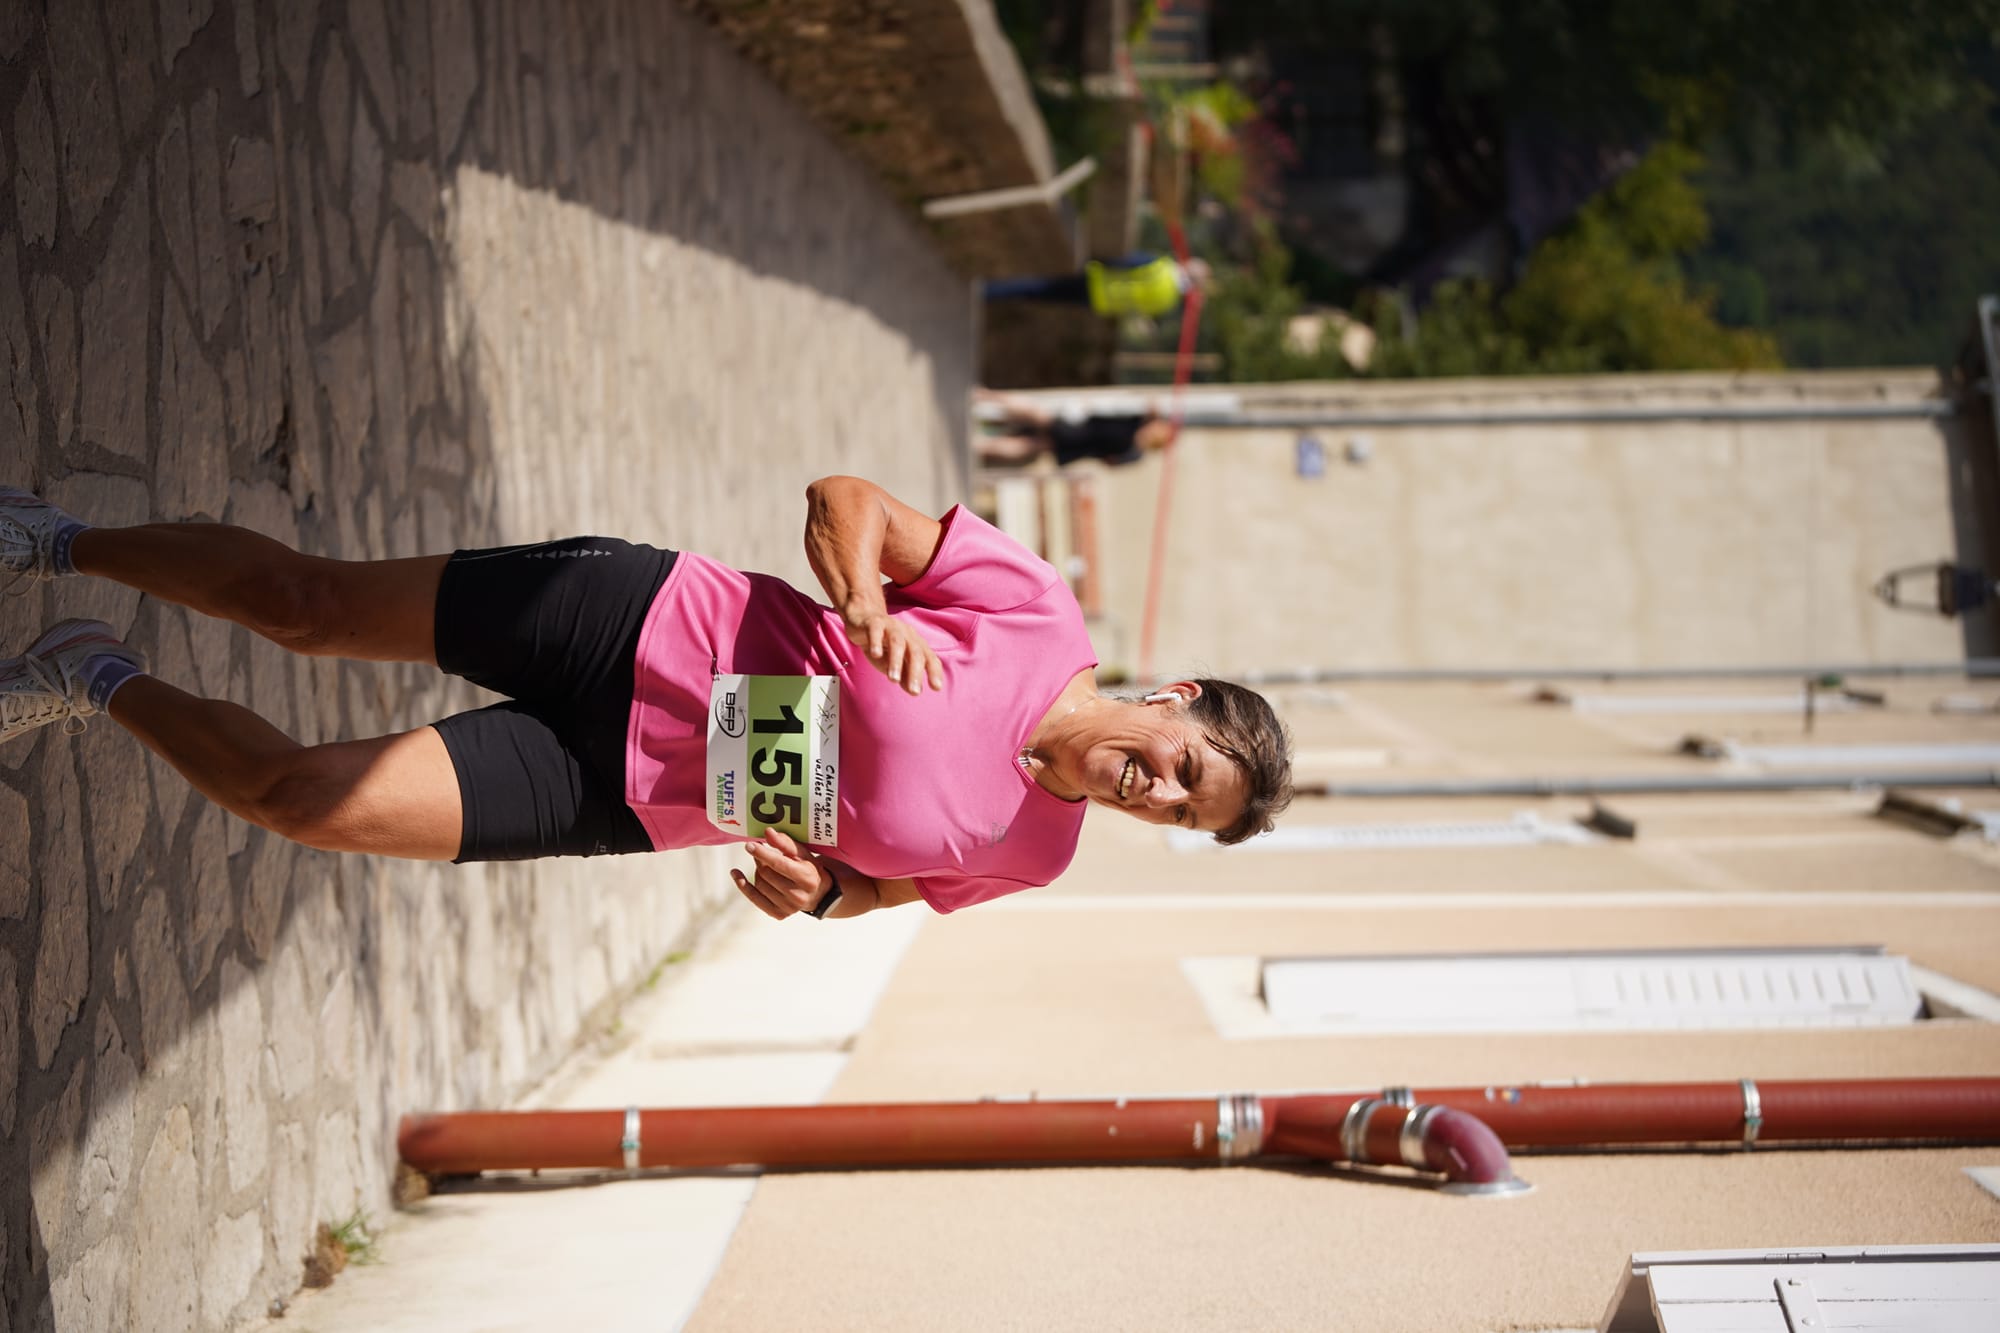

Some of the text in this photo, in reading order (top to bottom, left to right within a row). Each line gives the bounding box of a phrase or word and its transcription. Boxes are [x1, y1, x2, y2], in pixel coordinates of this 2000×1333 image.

[724, 692, 736, 731] BFP
[724, 770, 735, 816] TUFF'S
[750, 705, 804, 825] 155
[814, 758, 824, 840] vallées cévenoles
[822, 764, 835, 837] Challenge des
